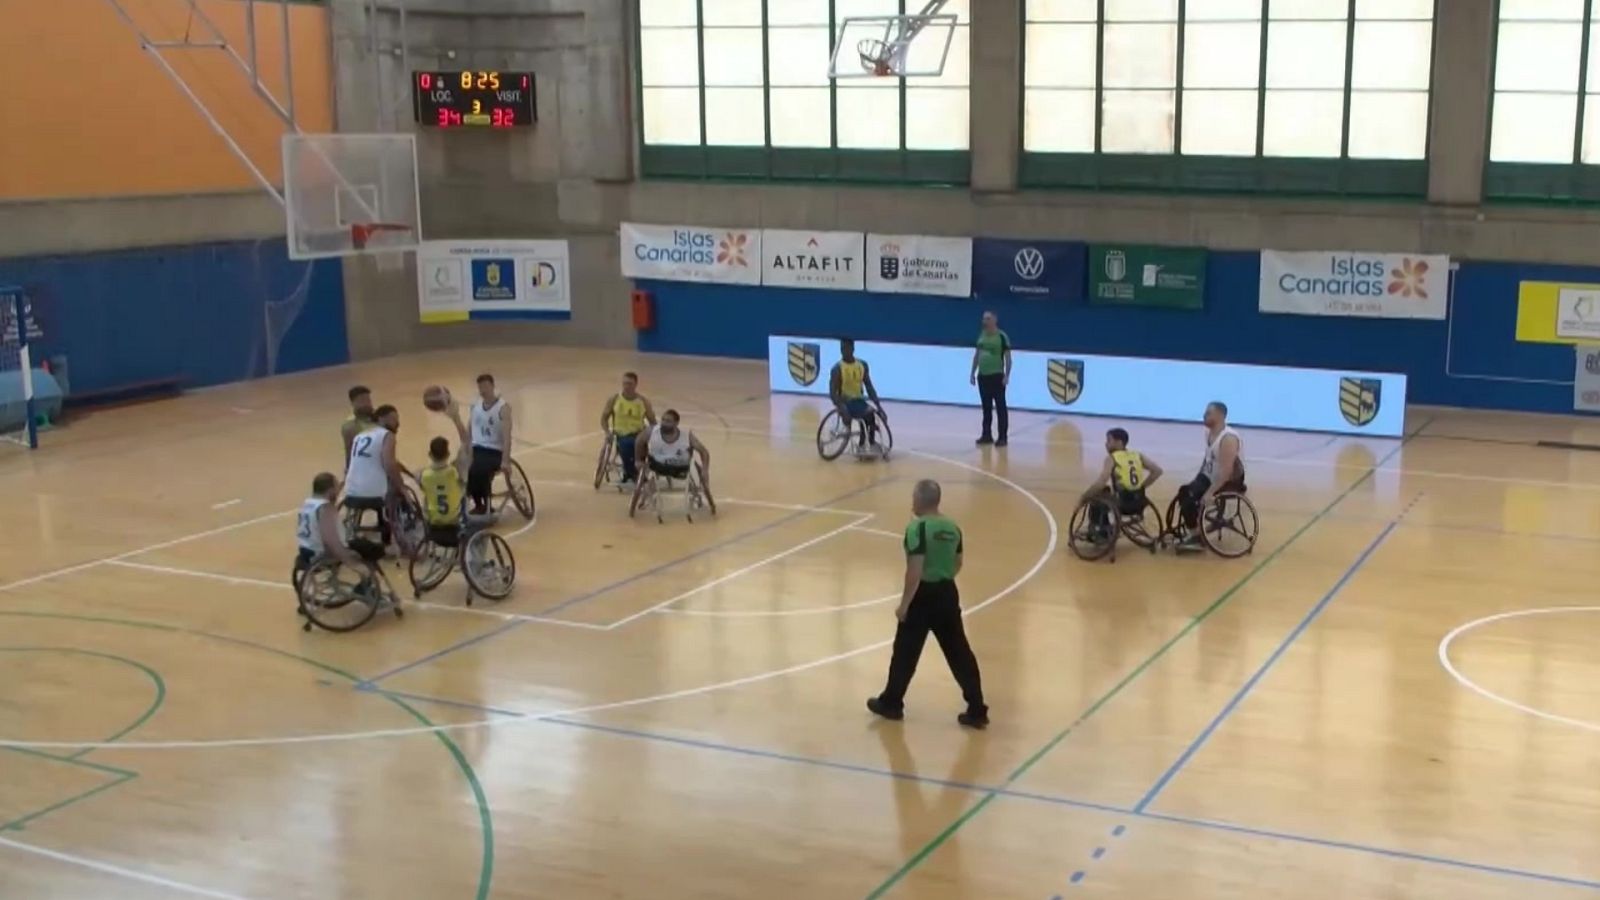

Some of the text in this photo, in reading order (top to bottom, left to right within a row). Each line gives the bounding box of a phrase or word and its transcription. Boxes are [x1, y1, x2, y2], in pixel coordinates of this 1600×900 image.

[420, 73, 431, 89] 0
[461, 71, 500, 89] 8:25
[521, 75, 528, 88] 1
[472, 99, 481, 114] 3
[438, 107, 461, 127] 34
[493, 107, 515, 127] 32
[673, 229, 715, 248] Islas
[634, 243, 715, 265] Canarias
[773, 255, 854, 271] ALTAFIT
[902, 258, 949, 268] Gobierno
[902, 268, 959, 280] de Canarias
[1331, 255, 1384, 277] Islas
[1279, 273, 1384, 296] Canarias
[352, 436, 373, 458] 12
[1129, 466, 1139, 486] 6
[437, 494, 449, 515] 5
